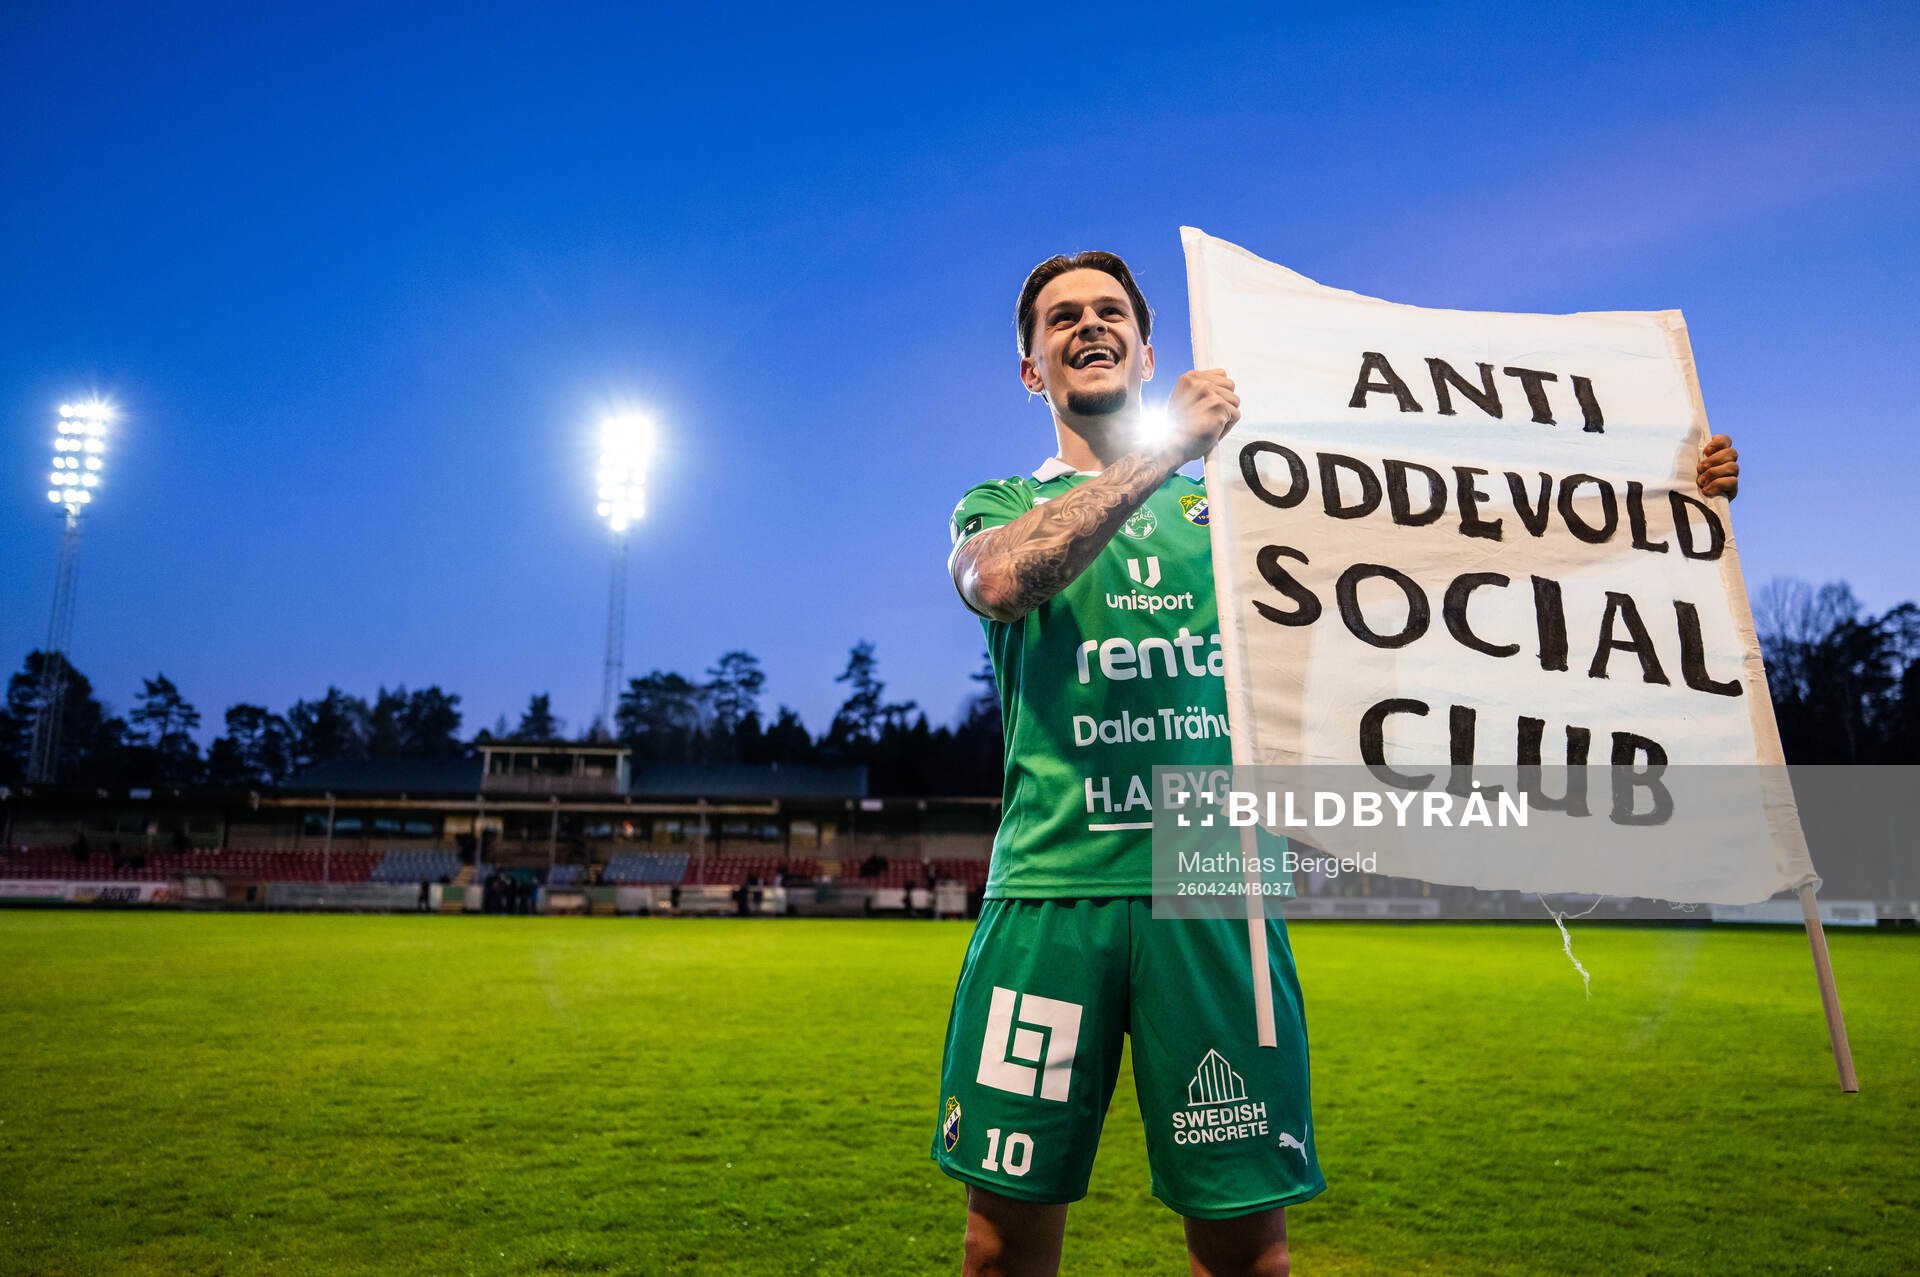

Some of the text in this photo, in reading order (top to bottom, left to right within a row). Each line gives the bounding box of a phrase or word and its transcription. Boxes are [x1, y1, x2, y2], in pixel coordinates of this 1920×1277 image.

[1348, 351, 1605, 433] ANTI
[1187, 501, 1208, 518] LSK
[1239, 440, 1726, 561] ODDEVOLD
[1106, 589, 1194, 614] unisport
[1251, 544, 1743, 697] SOCIAL
[1073, 710, 1156, 747] Dala
[1359, 698, 1674, 826] CLUB
[1172, 1102, 1267, 1129] SWEDISH
[1174, 1121, 1270, 1145] CONCRETE
[981, 1128, 1034, 1177] 10
